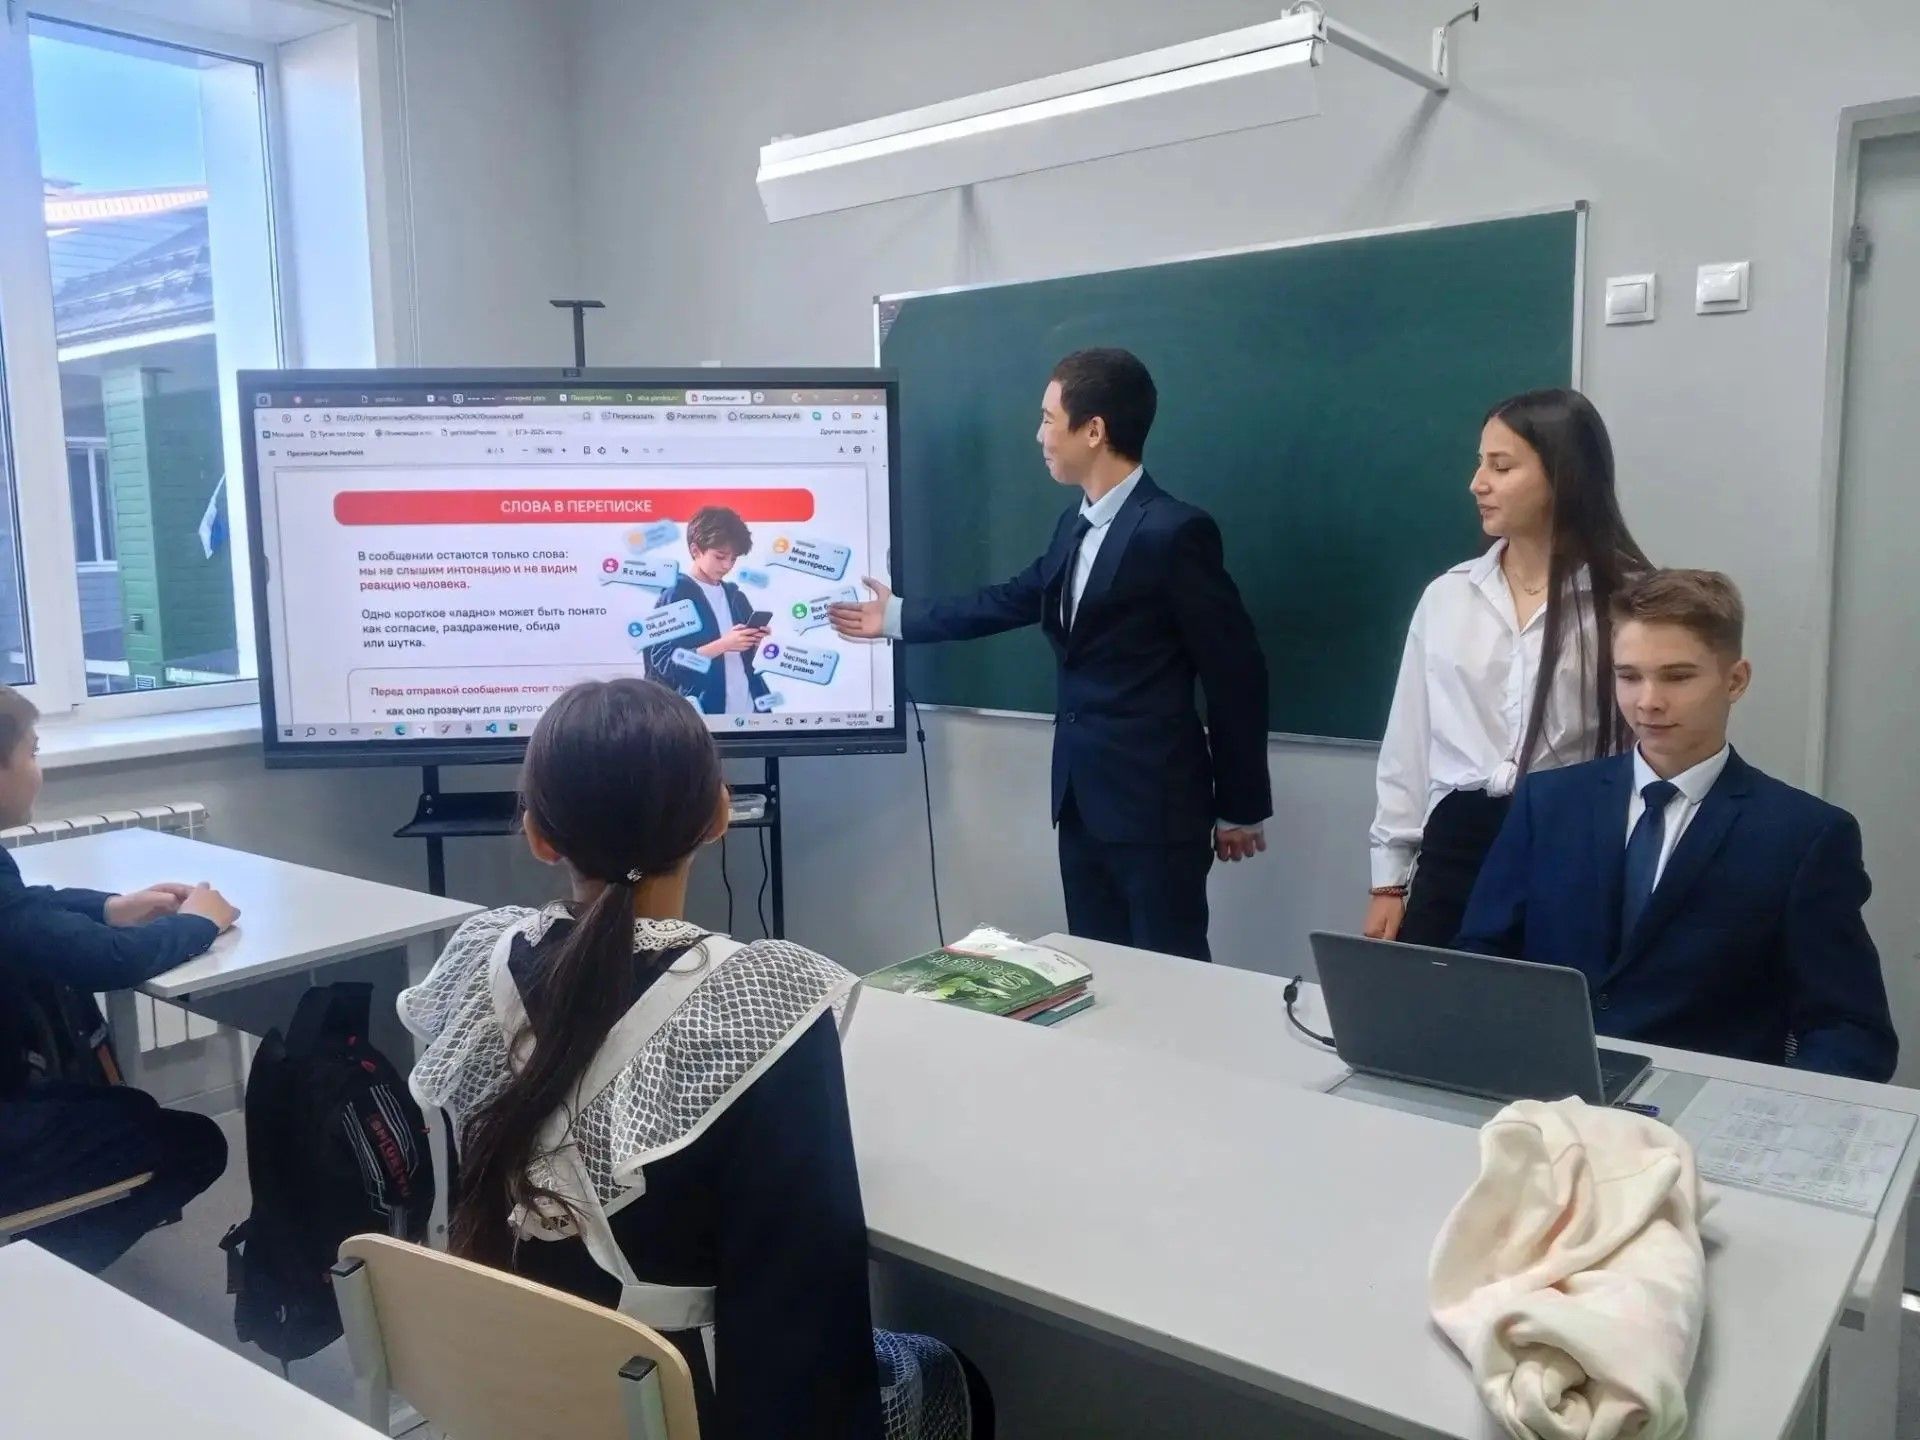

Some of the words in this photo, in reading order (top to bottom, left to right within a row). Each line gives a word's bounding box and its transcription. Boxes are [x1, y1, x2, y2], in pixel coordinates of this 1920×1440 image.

[501, 500, 550, 512] СЛОВА
[555, 501, 563, 512] В
[567, 500, 652, 512] ПЕРЕПИСКЕ
[358, 551, 365, 560] В
[369, 551, 433, 562] сообщении
[436, 551, 488, 560] остаются
[492, 550, 529, 559] только
[532, 550, 568, 559] слова:
[792, 547, 806, 556] Мне
[359, 567, 376, 575] мы
[380, 567, 393, 575] не
[396, 566, 444, 575] слышим
[446, 566, 510, 575] интонацию
[524, 565, 538, 574] не
[541, 565, 577, 574] видим
[799, 558, 835, 572] интересно
[360, 581, 410, 592] реакцию
[413, 580, 470, 590] человека.
[362, 609, 391, 621] Одно
[394, 610, 445, 618] короткое
[449, 609, 496, 619] «ладно»
[499, 608, 534, 617] может
[538, 606, 564, 616] быть
[568, 607, 606, 616] понято
[363, 625, 382, 633] как
[385, 624, 439, 634] согласие,
[443, 622, 522, 634] раздражение,
[526, 621, 560, 632] обида
[364, 639, 384, 648] или
[388, 638, 425, 649] шутка.
[793, 666, 814, 674] равно
[371, 687, 403, 697] Перед
[406, 685, 458, 696] отправкой
[462, 686, 518, 695] сообщения
[522, 685, 549, 693] стоит
[386, 707, 404, 715] как
[406, 707, 425, 715] оно
[428, 706, 480, 716] прозвучит
[483, 706, 501, 714] для
[504, 704, 543, 714] другого
